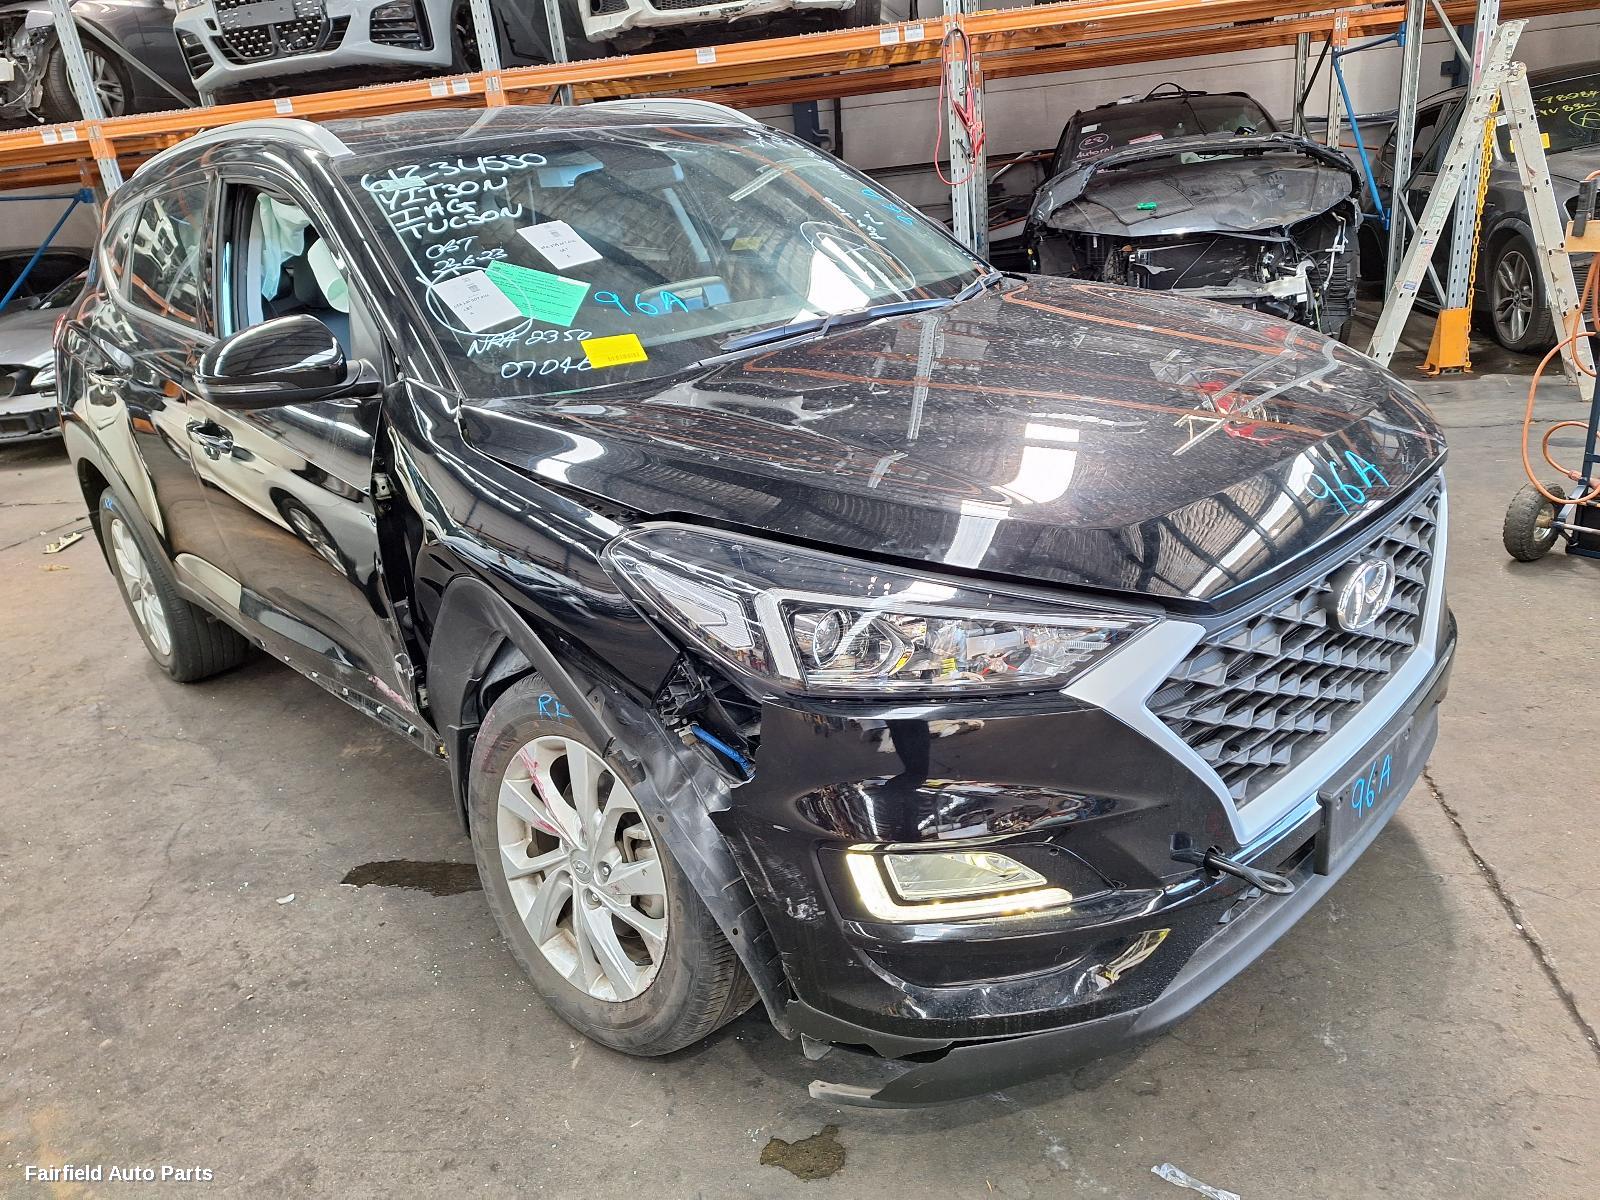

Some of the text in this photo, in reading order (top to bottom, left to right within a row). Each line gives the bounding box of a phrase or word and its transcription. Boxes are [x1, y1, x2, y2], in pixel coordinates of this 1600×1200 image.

[398, 203, 523, 239] TUCSON
[1303, 450, 1391, 516] 96A
[1351, 753, 1393, 819] 96A
